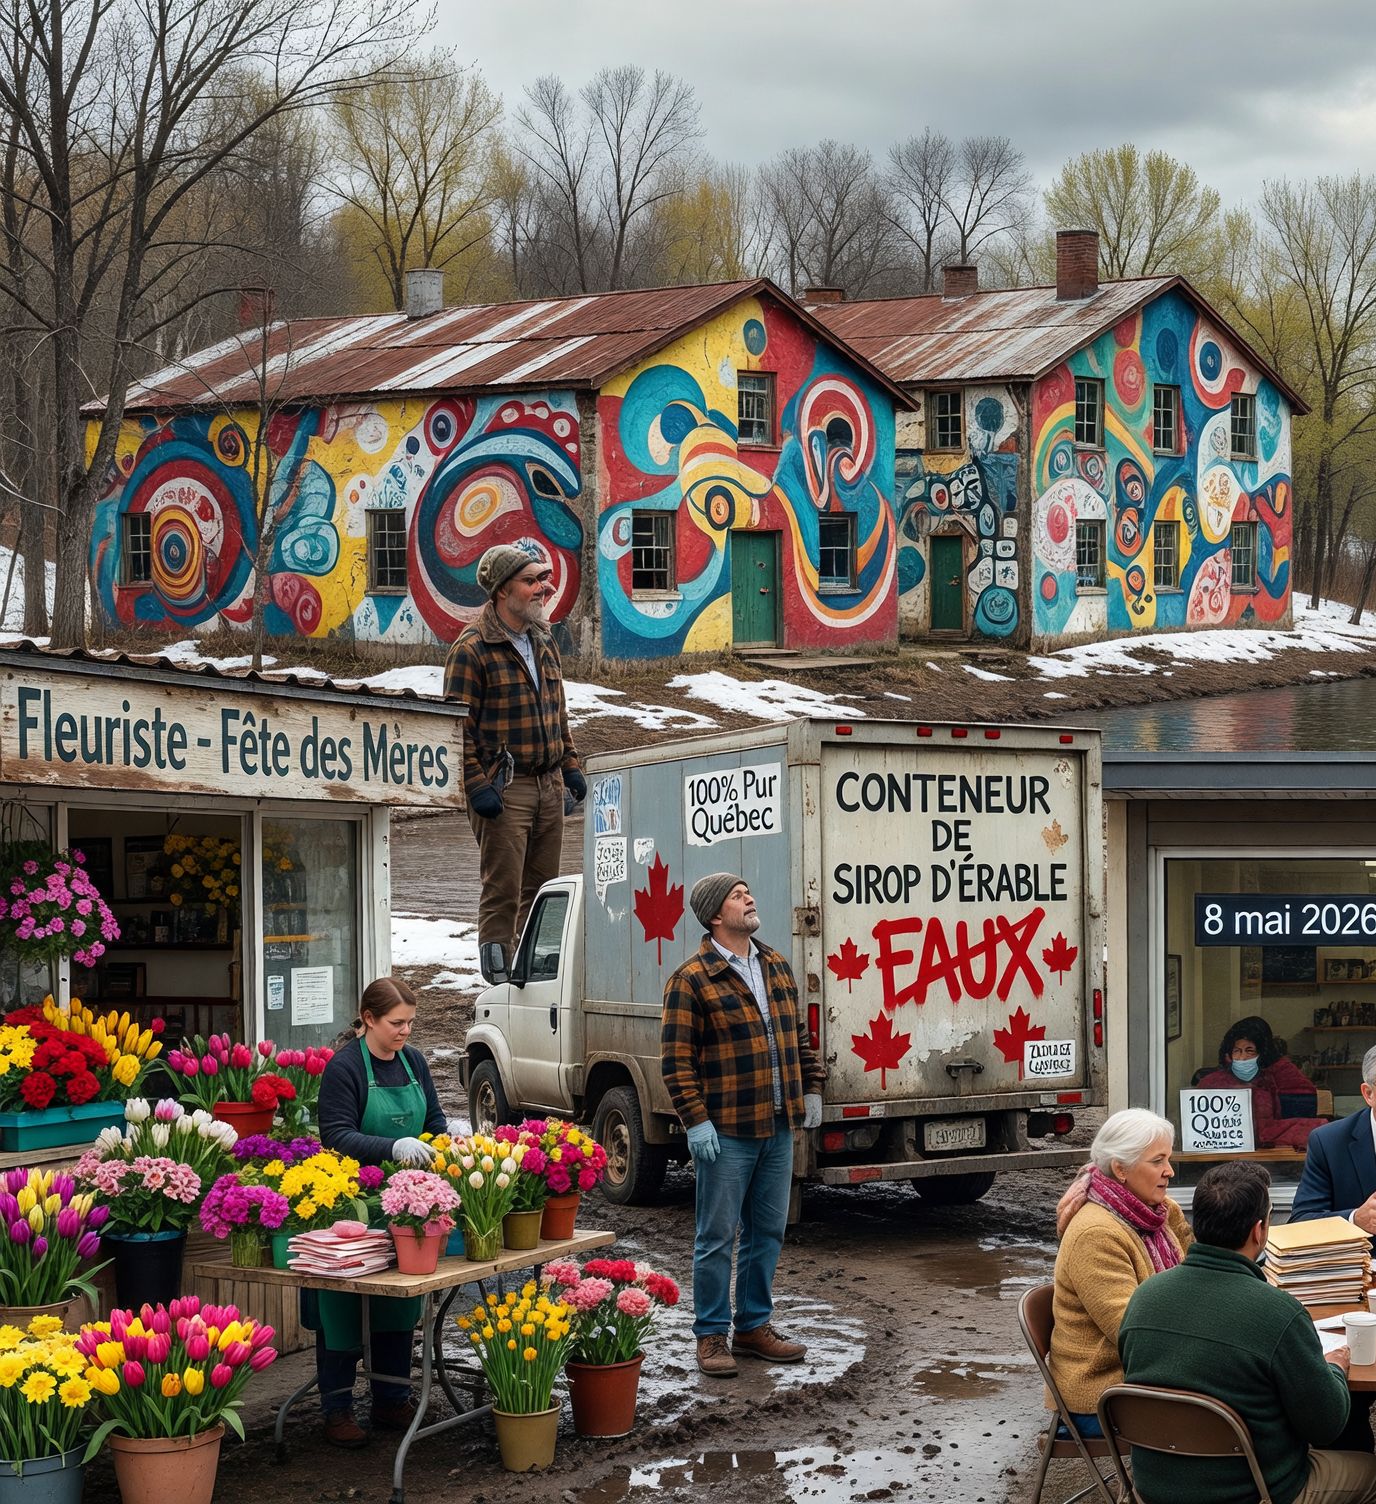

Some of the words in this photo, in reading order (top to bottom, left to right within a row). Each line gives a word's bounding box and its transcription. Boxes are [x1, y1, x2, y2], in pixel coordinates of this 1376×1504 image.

[18, 686, 188, 771] Fleuriste
[221, 708, 291, 777] Fête
[300, 716, 353, 781] des
[363, 721, 450, 788] Mères
[688, 774, 738, 806] 100%
[743, 769, 777, 800] Pur
[836, 771, 1051, 814] CONTENEUR
[691, 802, 774, 843] Québec
[931, 819, 972, 851] DE
[832, 863, 922, 904] SIROP
[931, 853, 1068, 903] D'ÉRABLE
[1203, 903, 1224, 935] 8
[1234, 903, 1291, 935] mai
[1188, 1095, 1241, 1114] 100%
